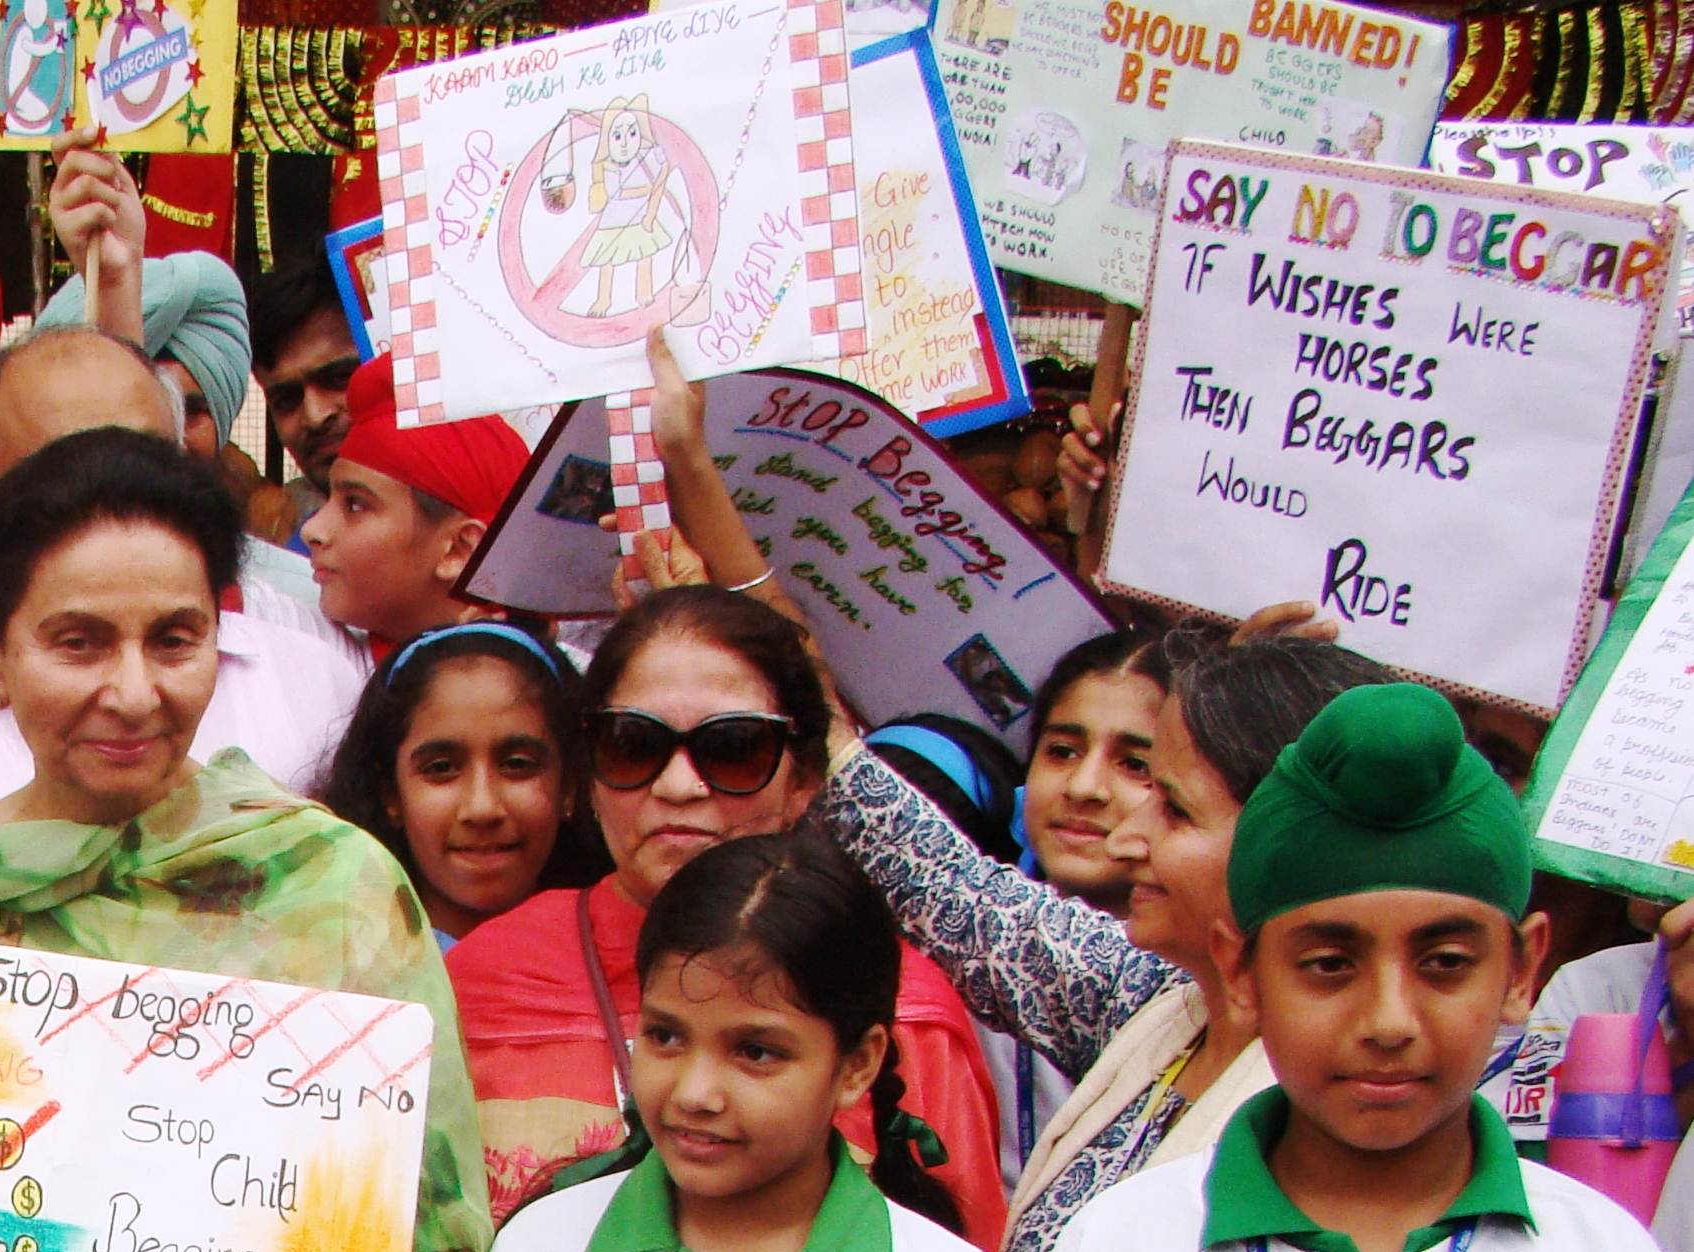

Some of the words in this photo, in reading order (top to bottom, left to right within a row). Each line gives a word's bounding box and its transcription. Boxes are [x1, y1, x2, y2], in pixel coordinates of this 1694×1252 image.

[503, 48, 559, 79] KARO
[682, 9, 741, 40] LIYE
[983, 58, 1012, 81] ARE
[1099, 1, 1240, 75] SHOULD
[1246, 0, 1421, 88] BANNED!
[943, 71, 969, 87] ORE
[1115, 52, 1173, 110] BE
[874, 171, 931, 208] Give
[1456, 136, 1631, 192] STOP
[1174, 168, 1269, 228] SAY
[1293, 182, 1362, 243] NO
[1383, 191, 1438, 257] TO
[1447, 207, 1663, 300] BEGGAR
[893, 286, 975, 337] instead
[1180, 242, 1226, 294] IF
[1246, 252, 1401, 332] WISHES
[1448, 300, 1541, 356] WERE
[920, 361, 968, 394] WORK
[1294, 332, 1440, 402] HORSES
[1175, 367, 1256, 435] THEN
[1280, 388, 1477, 483] BEGGARS
[1196, 450, 1308, 519] WOULD
[851, 495, 928, 574] begging
[1321, 538, 1413, 627] RIDE
[110, 973, 256, 1060] begging
[121, 1104, 215, 1159] Stop
